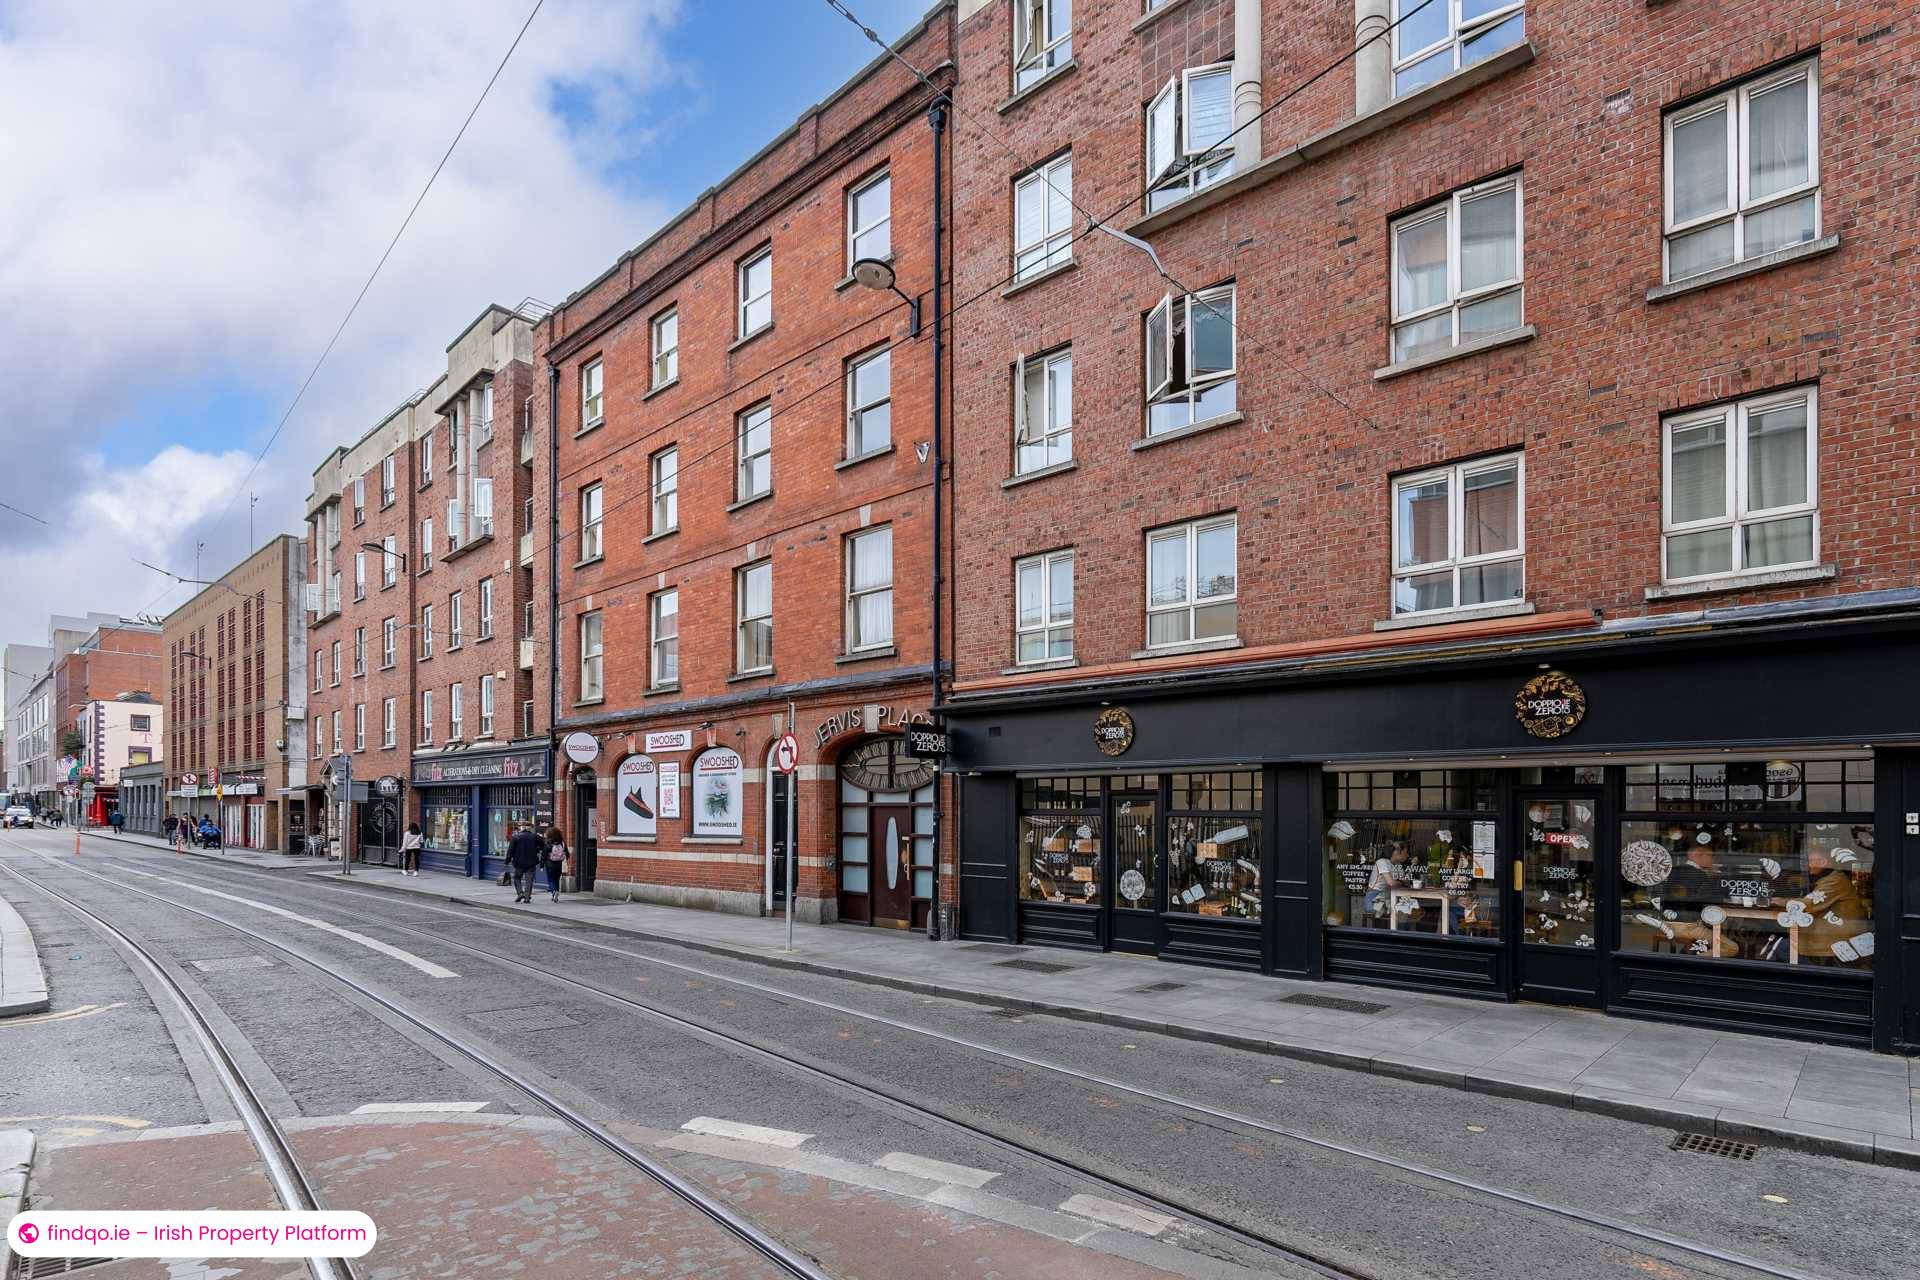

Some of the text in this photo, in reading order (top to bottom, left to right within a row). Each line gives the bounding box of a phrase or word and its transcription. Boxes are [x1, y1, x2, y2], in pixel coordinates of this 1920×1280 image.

[1528, 699, 1562, 709] DOPPIO
[1536, 706, 1562, 716] ZERO
[815, 708, 861, 749] JERVIS
[650, 734, 685, 747] SWOOSHED
[910, 731, 939, 743] DOPPIO
[568, 744, 597, 752] SWOOSHED
[916, 741, 940, 753] ZERO
[700, 755, 739, 769] SWOOSHED
[480, 764, 502, 775] CLEANING
[622, 761, 655, 774] SWOOSHED
[1550, 834, 1576, 843] OPEN
[1405, 865, 1429, 876] AWAY
[1439, 867, 1453, 875] ANY
[1345, 876, 1367, 884] PASTRY
[1392, 871, 1415, 881] DEAL
[1444, 881, 1469, 889] PASTRY
[1720, 879, 1759, 889] DOPPIO
[1729, 887, 1759, 897] ZERO
